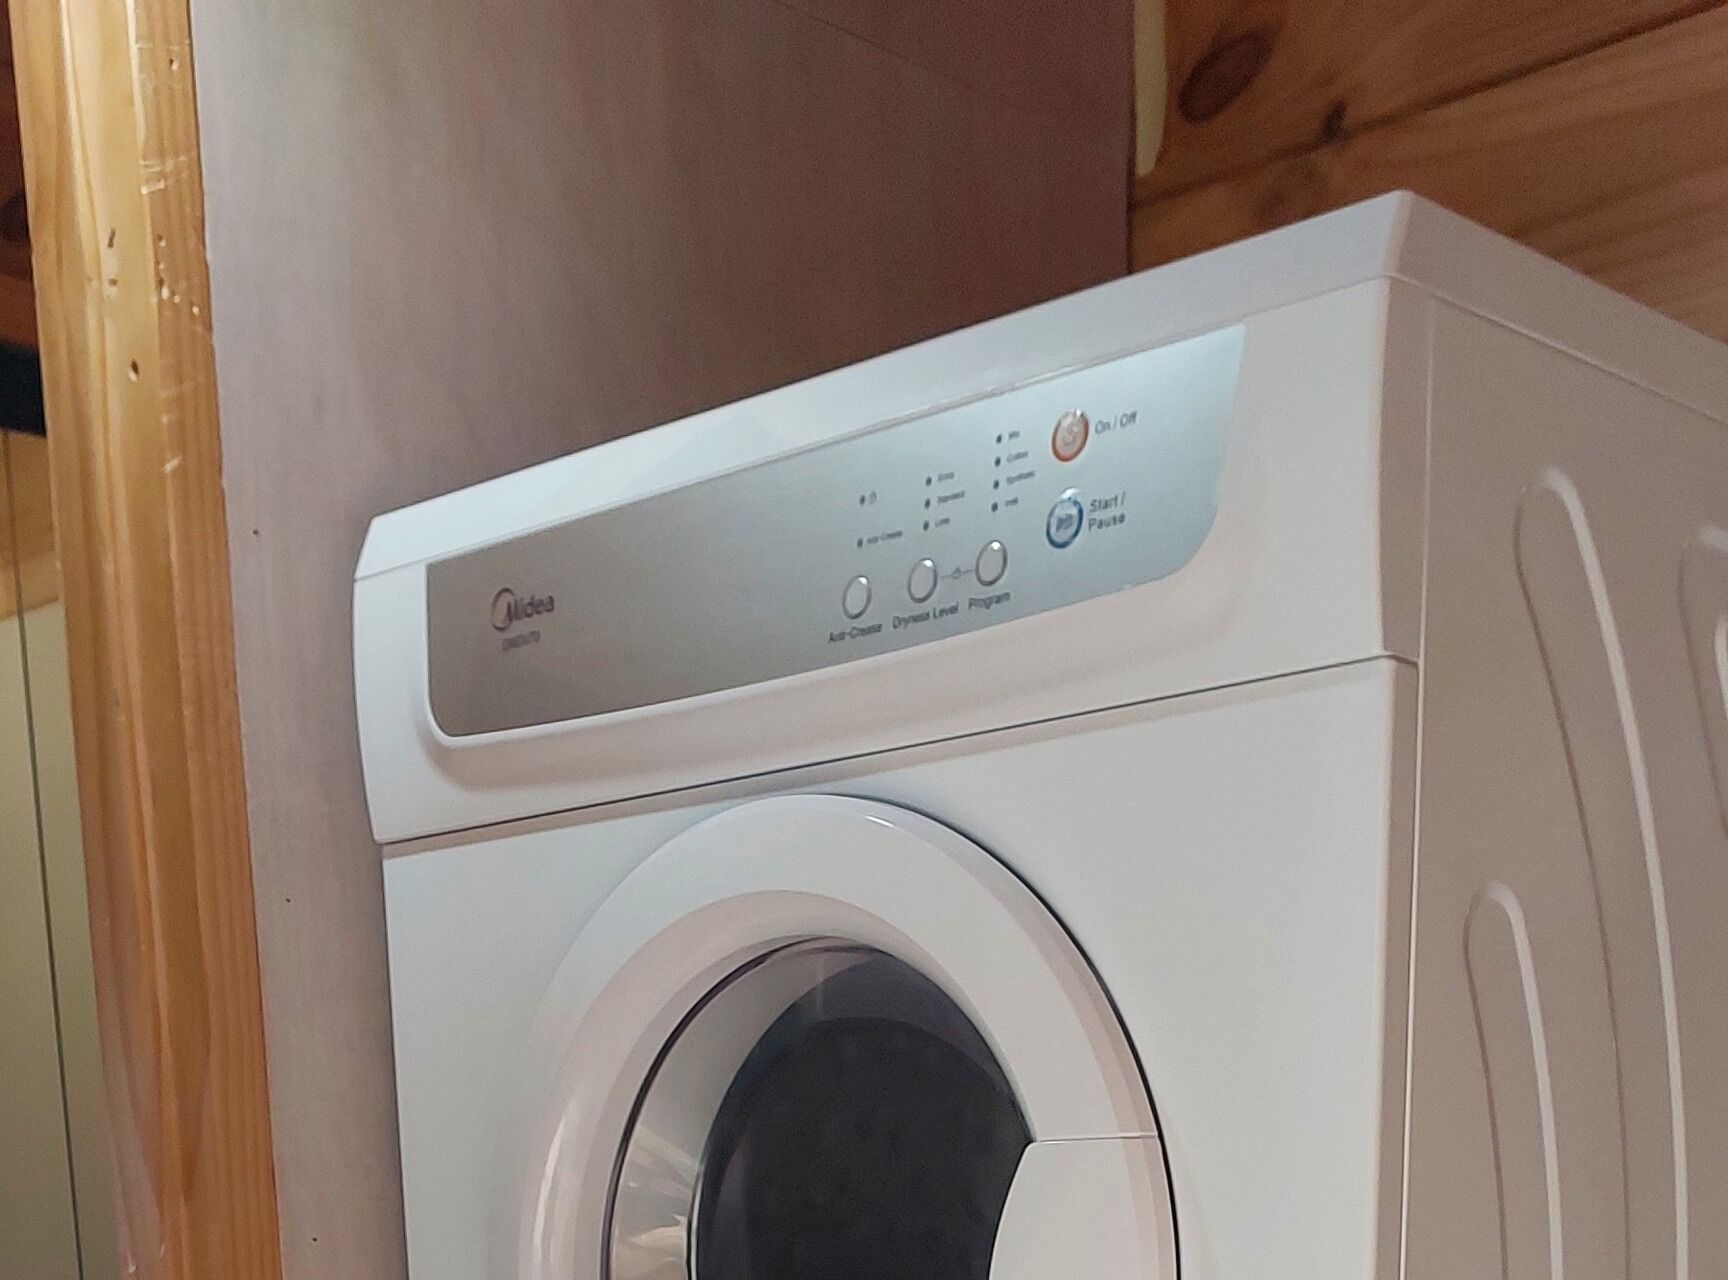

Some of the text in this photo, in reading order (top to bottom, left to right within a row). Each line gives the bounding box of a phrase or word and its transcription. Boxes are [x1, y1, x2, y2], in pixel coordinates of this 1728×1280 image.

[1095, 420, 1111, 435] On
[1120, 410, 1137, 428] Off
[1090, 495, 1118, 513] Start
[1089, 512, 1126, 532] Pause
[491, 587, 555, 632] Midea
[968, 592, 1010, 610] Program
[892, 602, 960, 630] Dryness Level
